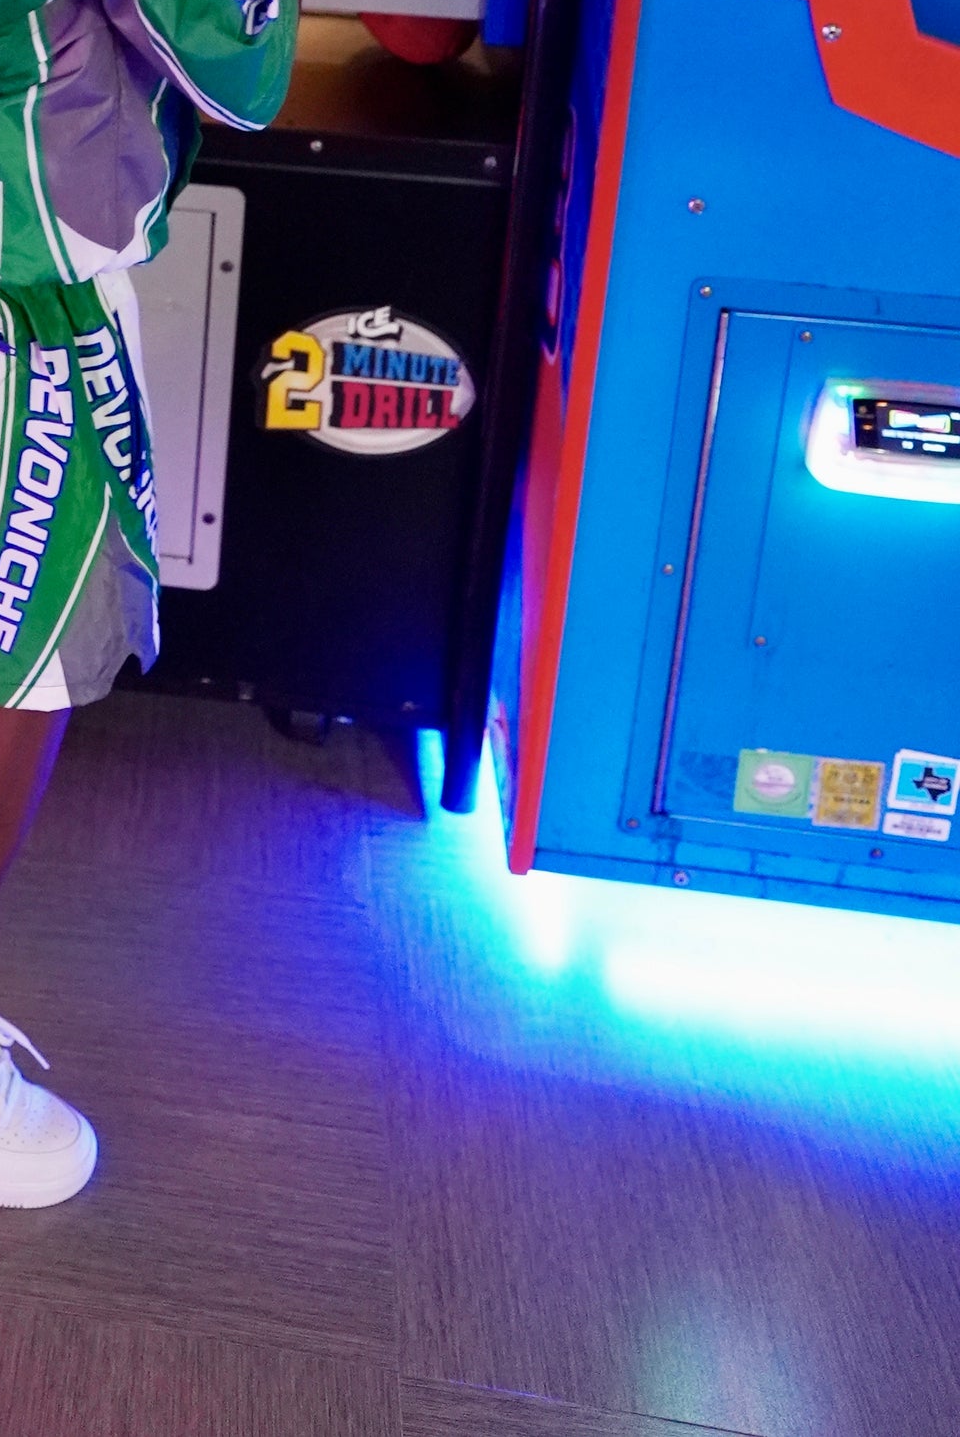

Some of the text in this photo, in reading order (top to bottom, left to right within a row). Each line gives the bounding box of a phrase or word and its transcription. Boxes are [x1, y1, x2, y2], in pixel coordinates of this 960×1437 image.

[347, 306, 403, 338] ICE
[266, 330, 462, 430] 2 MINUTE
[338, 380, 460, 429] DRILL
